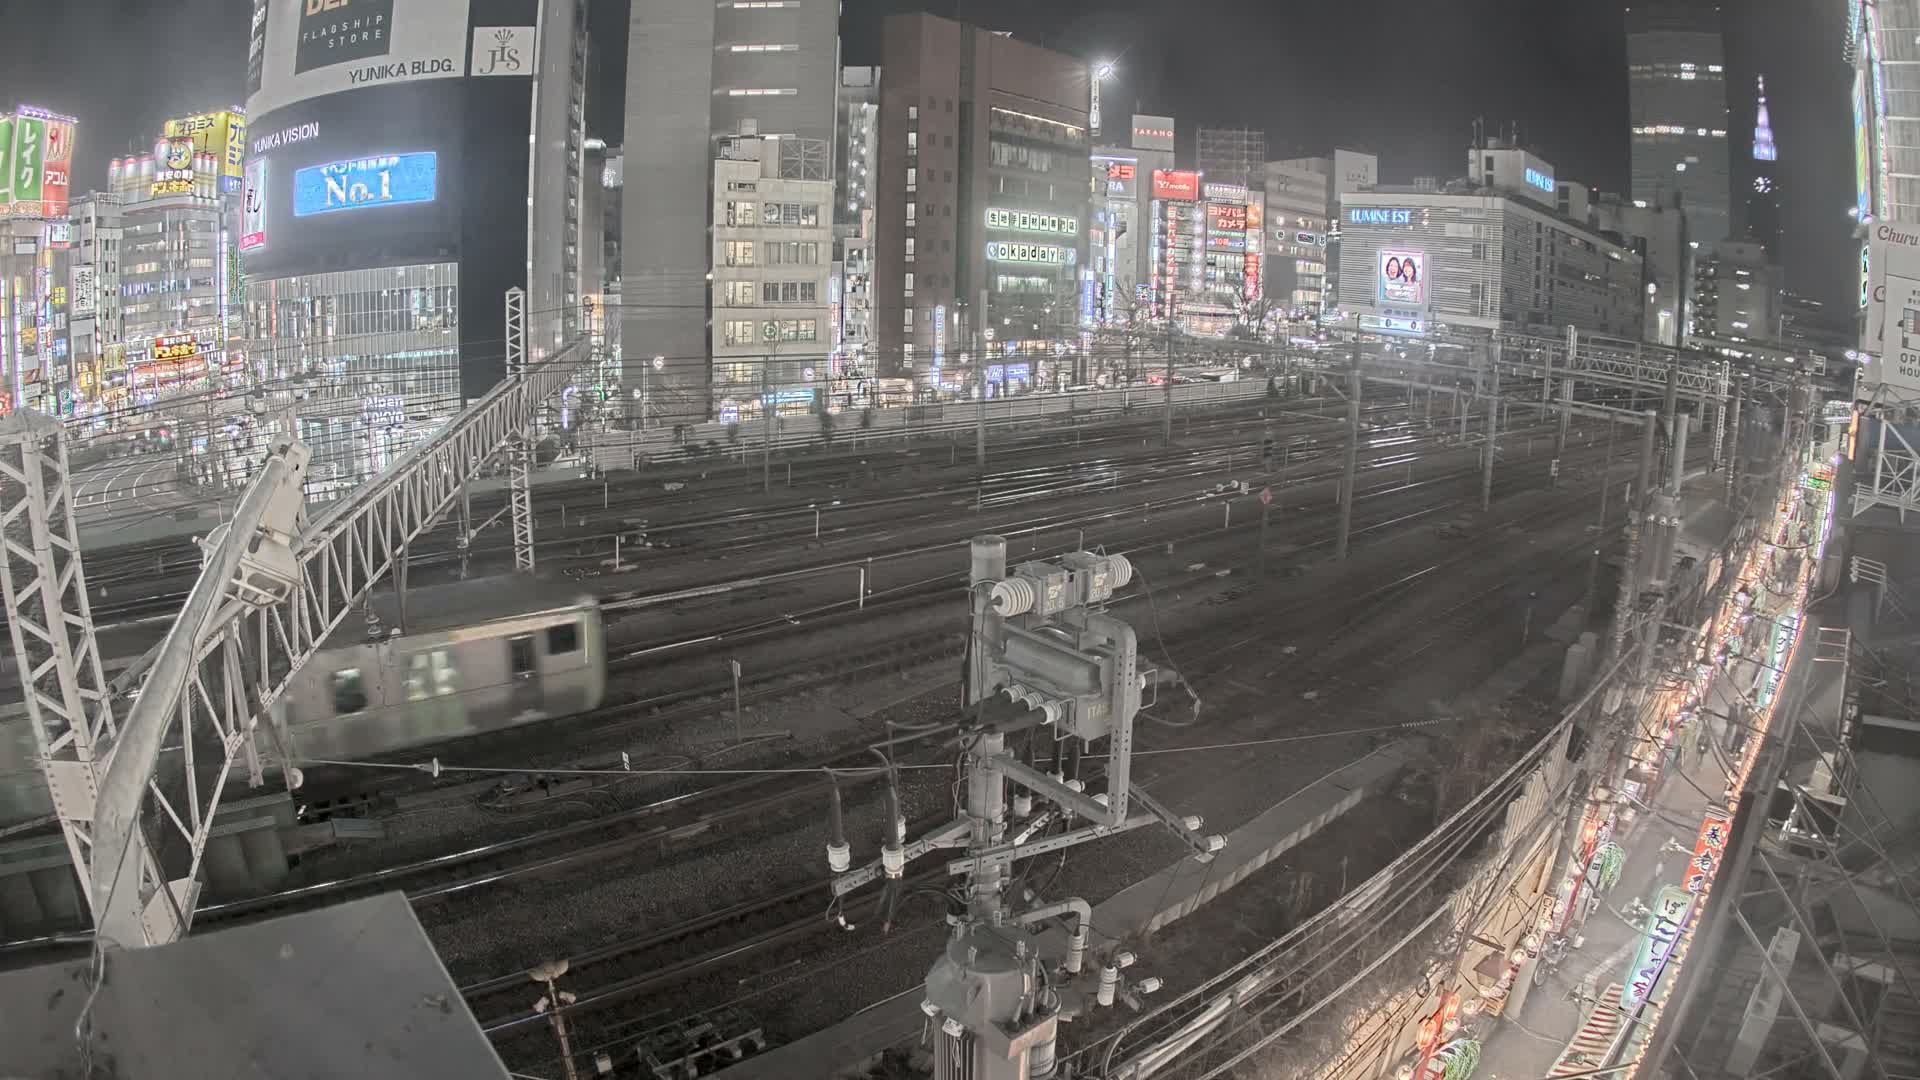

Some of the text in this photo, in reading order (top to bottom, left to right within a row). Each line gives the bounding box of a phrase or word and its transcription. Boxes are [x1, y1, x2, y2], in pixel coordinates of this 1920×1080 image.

[303, 15, 383, 43] FLAGSHIP
[328, 29, 382, 48] STORE
[349, 57, 456, 85] YUNIKA BLDG.
[254, 121, 319, 154] YUNIKA VISION
[1135, 127, 1174, 137] TAKANO
[20, 121, 37, 189] レイク
[44, 170, 69, 186] アコム
[325, 169, 393, 207] No.1
[1207, 206, 1245, 217] ヨドバシ
[1217, 219, 1245, 229] カメラ
[1000, 246, 1065, 261] okadaya
[1900, 352, 1920, 366] OP
